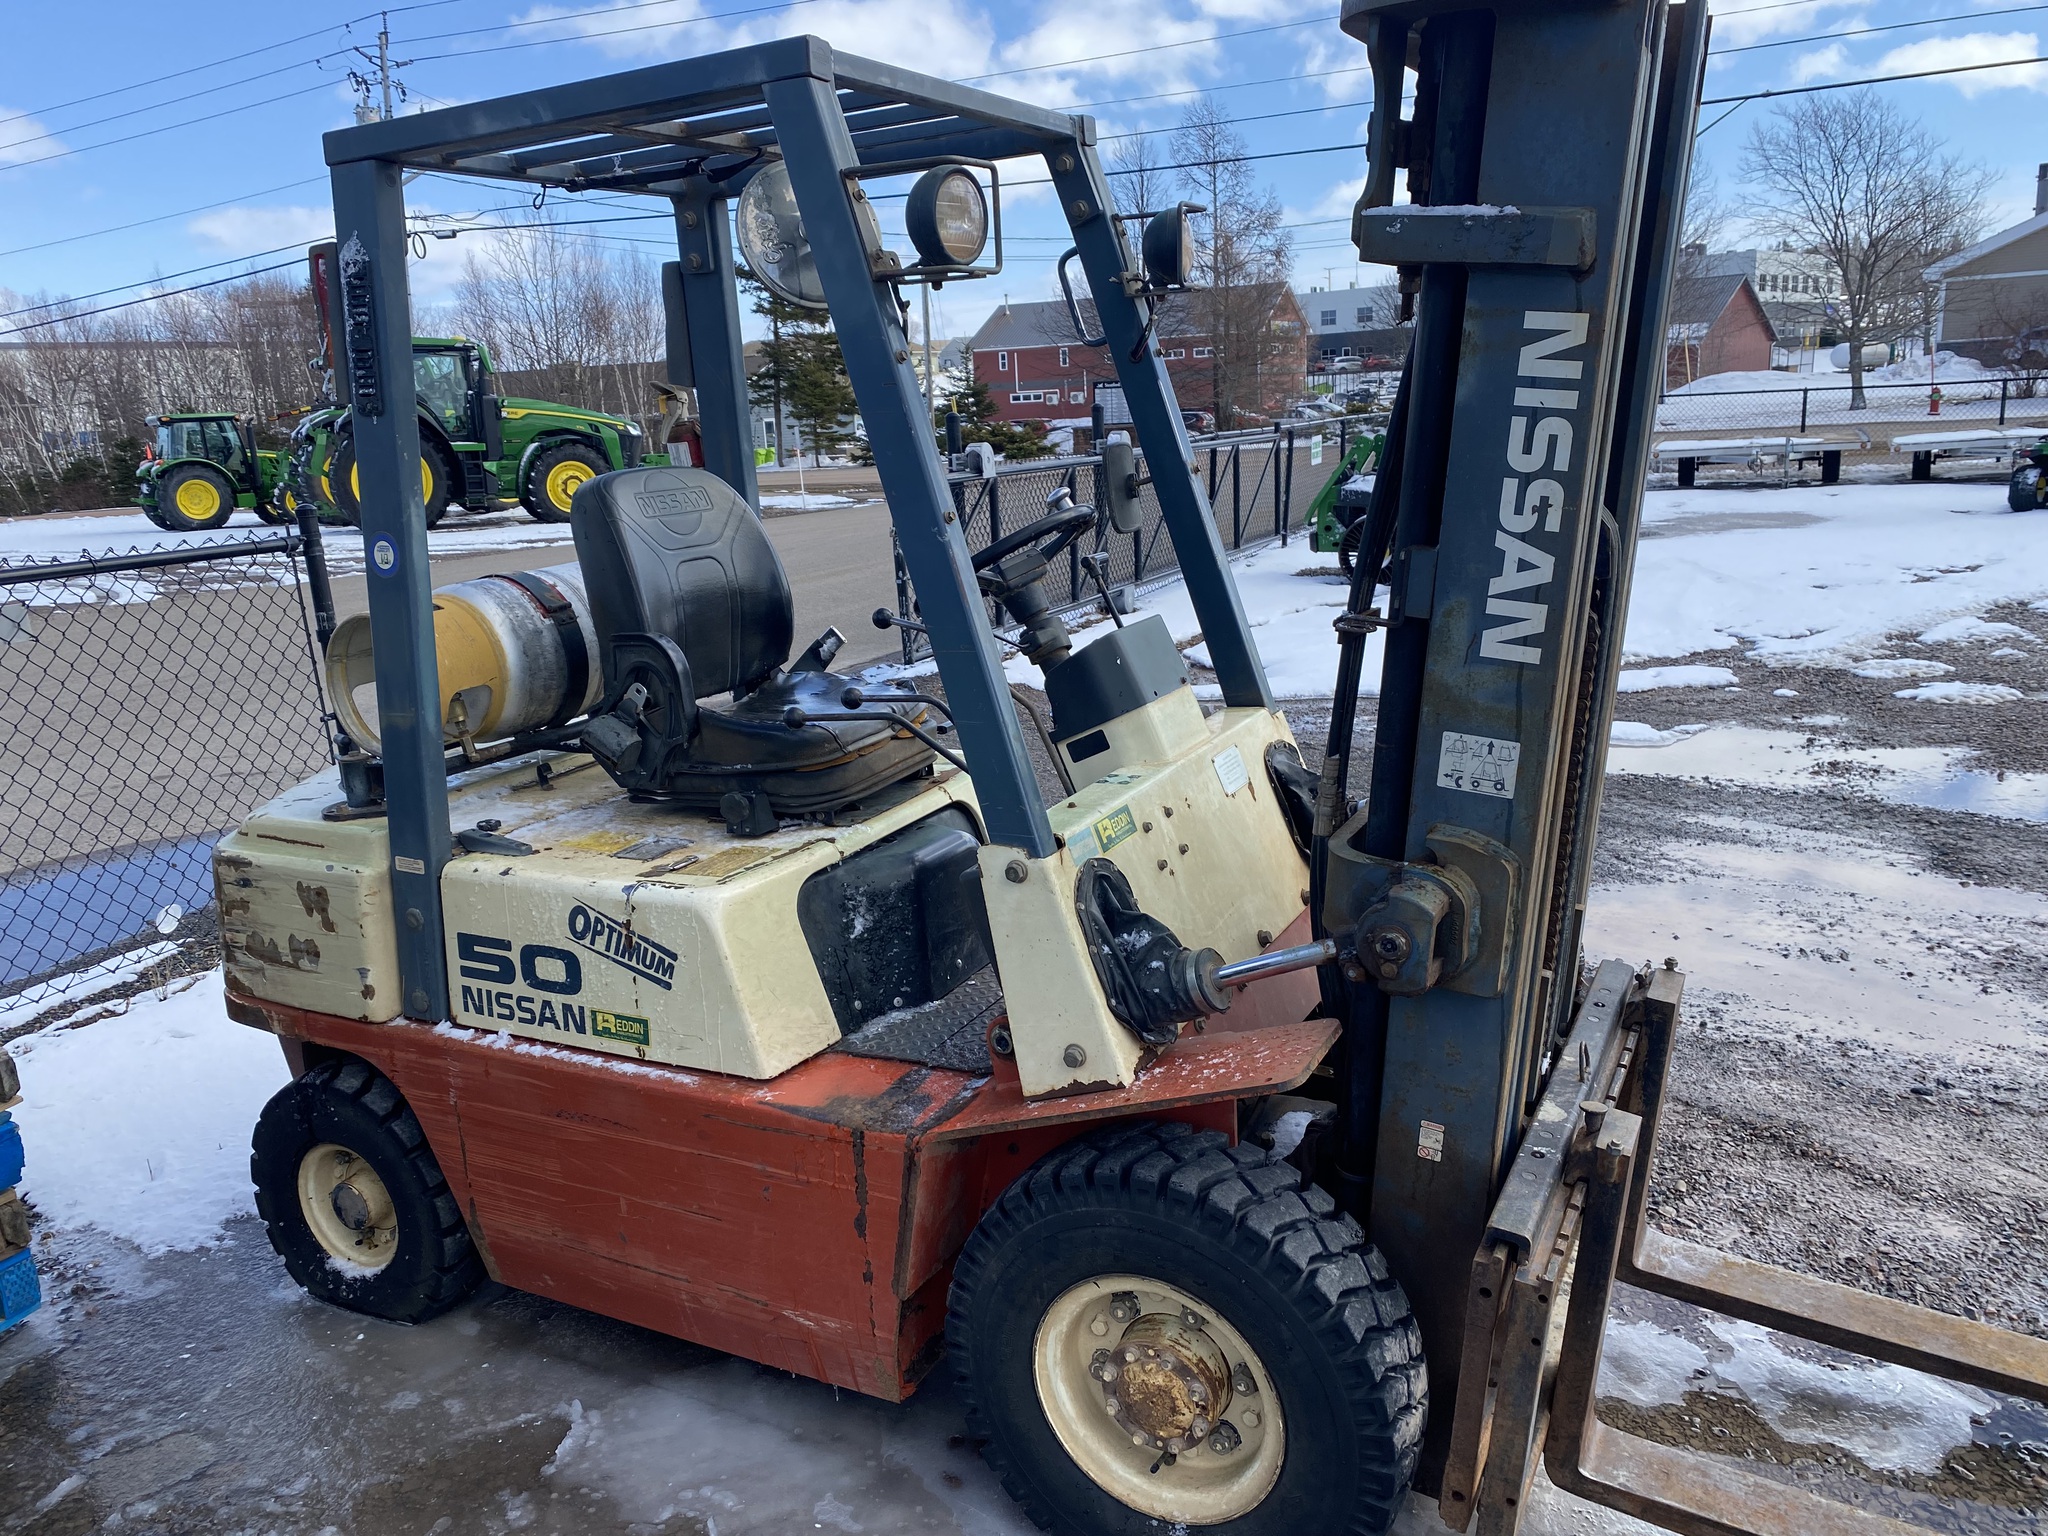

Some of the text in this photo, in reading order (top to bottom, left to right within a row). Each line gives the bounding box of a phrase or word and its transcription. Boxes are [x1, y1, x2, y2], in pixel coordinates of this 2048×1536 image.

[637, 489, 709, 516] NISSAN
[1480, 310, 1590, 665] NISSAN
[1097, 811, 1131, 844] REDDIN
[457, 932, 581, 995] 50
[567, 904, 675, 980] OPTIMUM
[461, 985, 587, 1035] NISSAN
[596, 1012, 643, 1034] REDDIN
